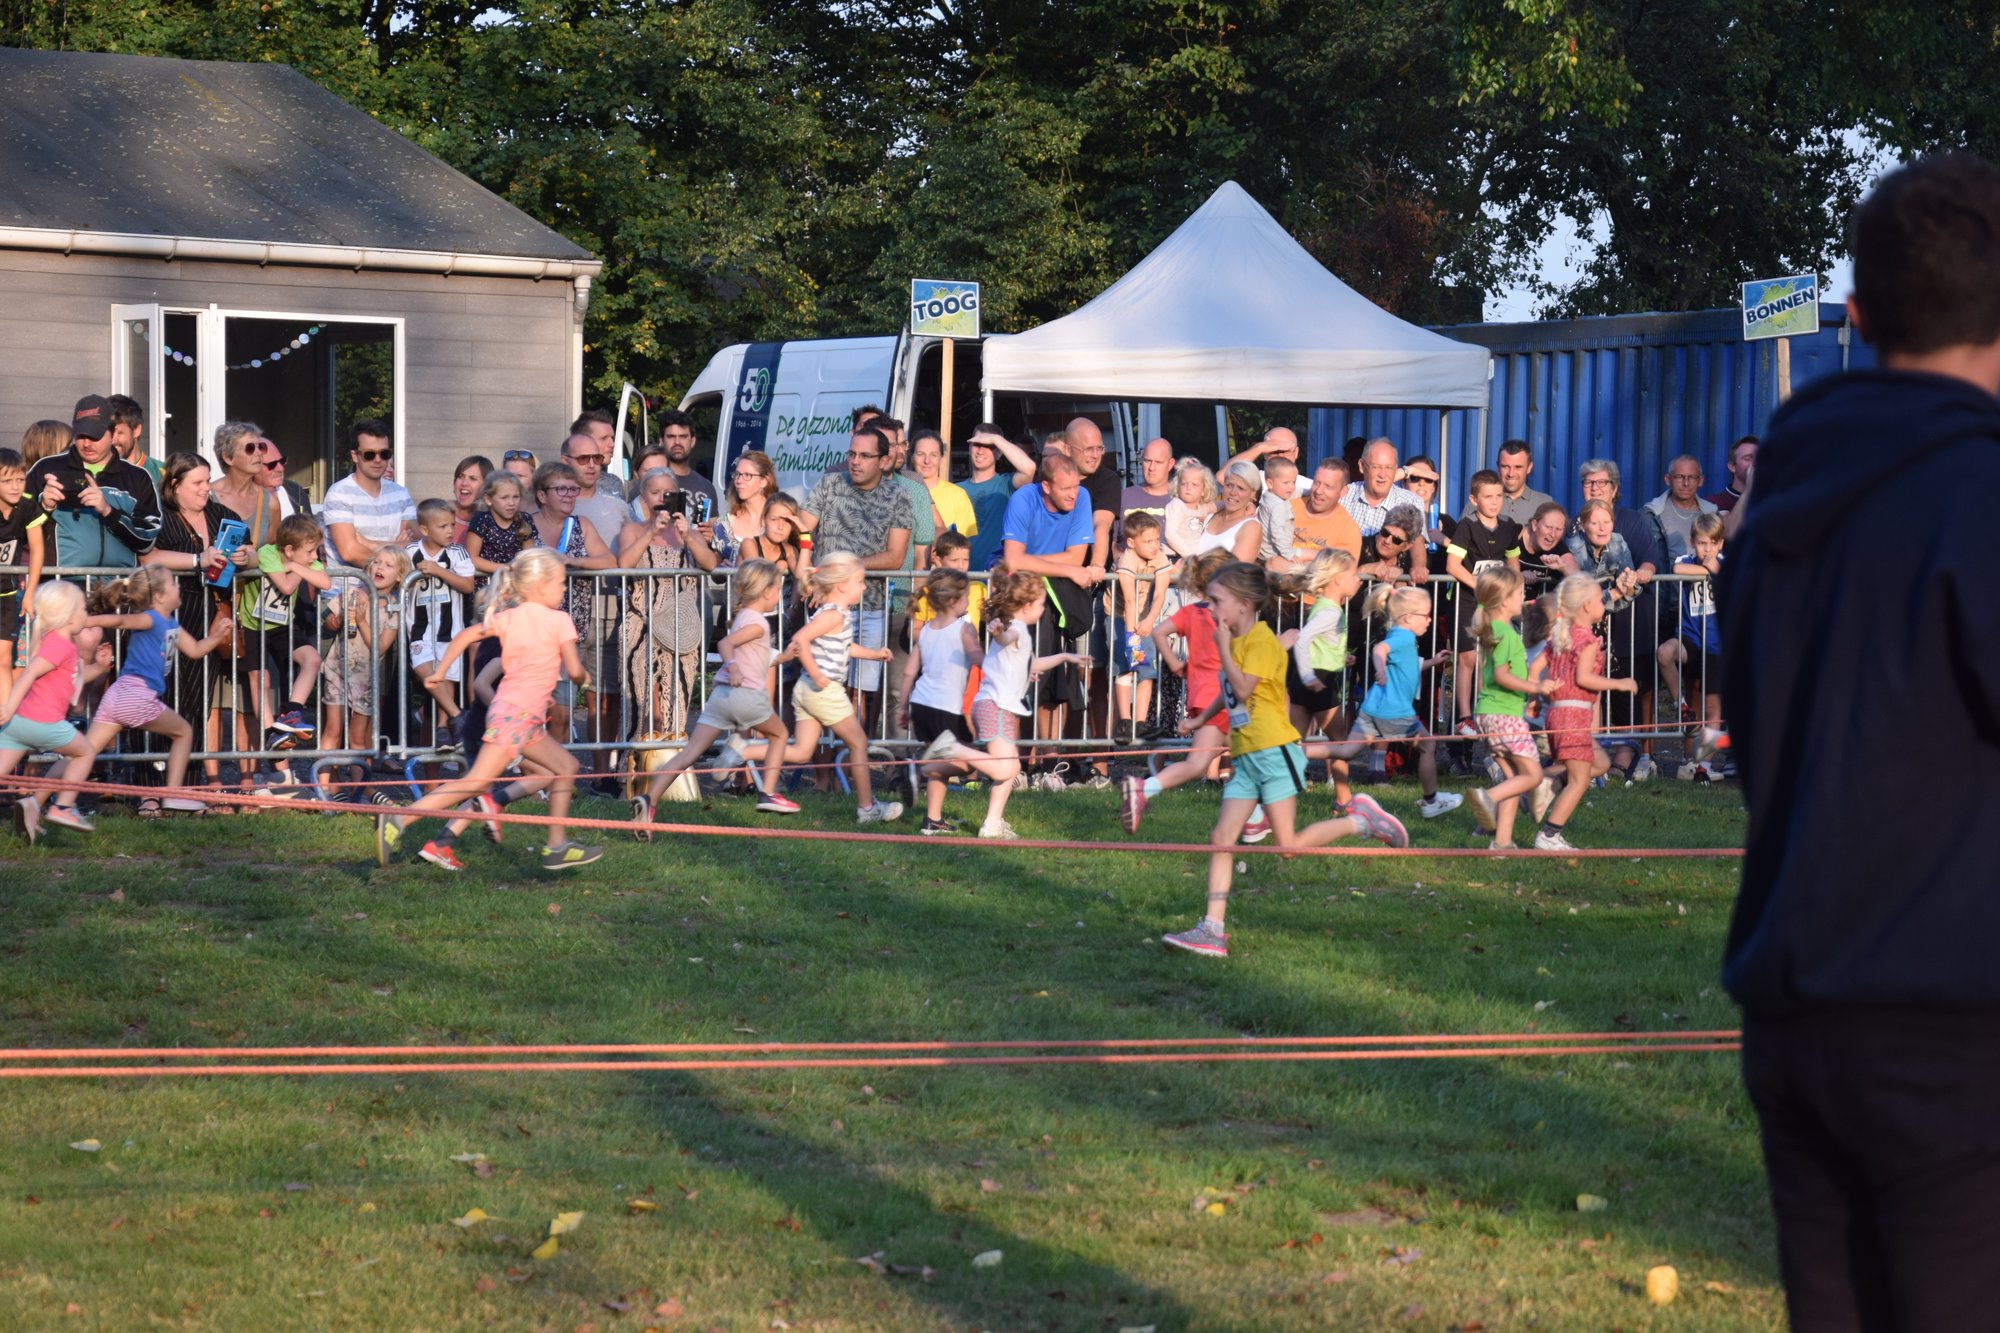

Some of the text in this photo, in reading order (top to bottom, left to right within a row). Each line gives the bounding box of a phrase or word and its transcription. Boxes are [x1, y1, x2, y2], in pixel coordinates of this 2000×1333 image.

[913, 293, 977, 321] TOOG
[1745, 287, 1815, 324] BONNEN
[740, 367, 770, 412] 50
[776, 415, 852, 444] De gezond
[772, 444, 847, 472] familieba
[0, 543, 11, 563] 8
